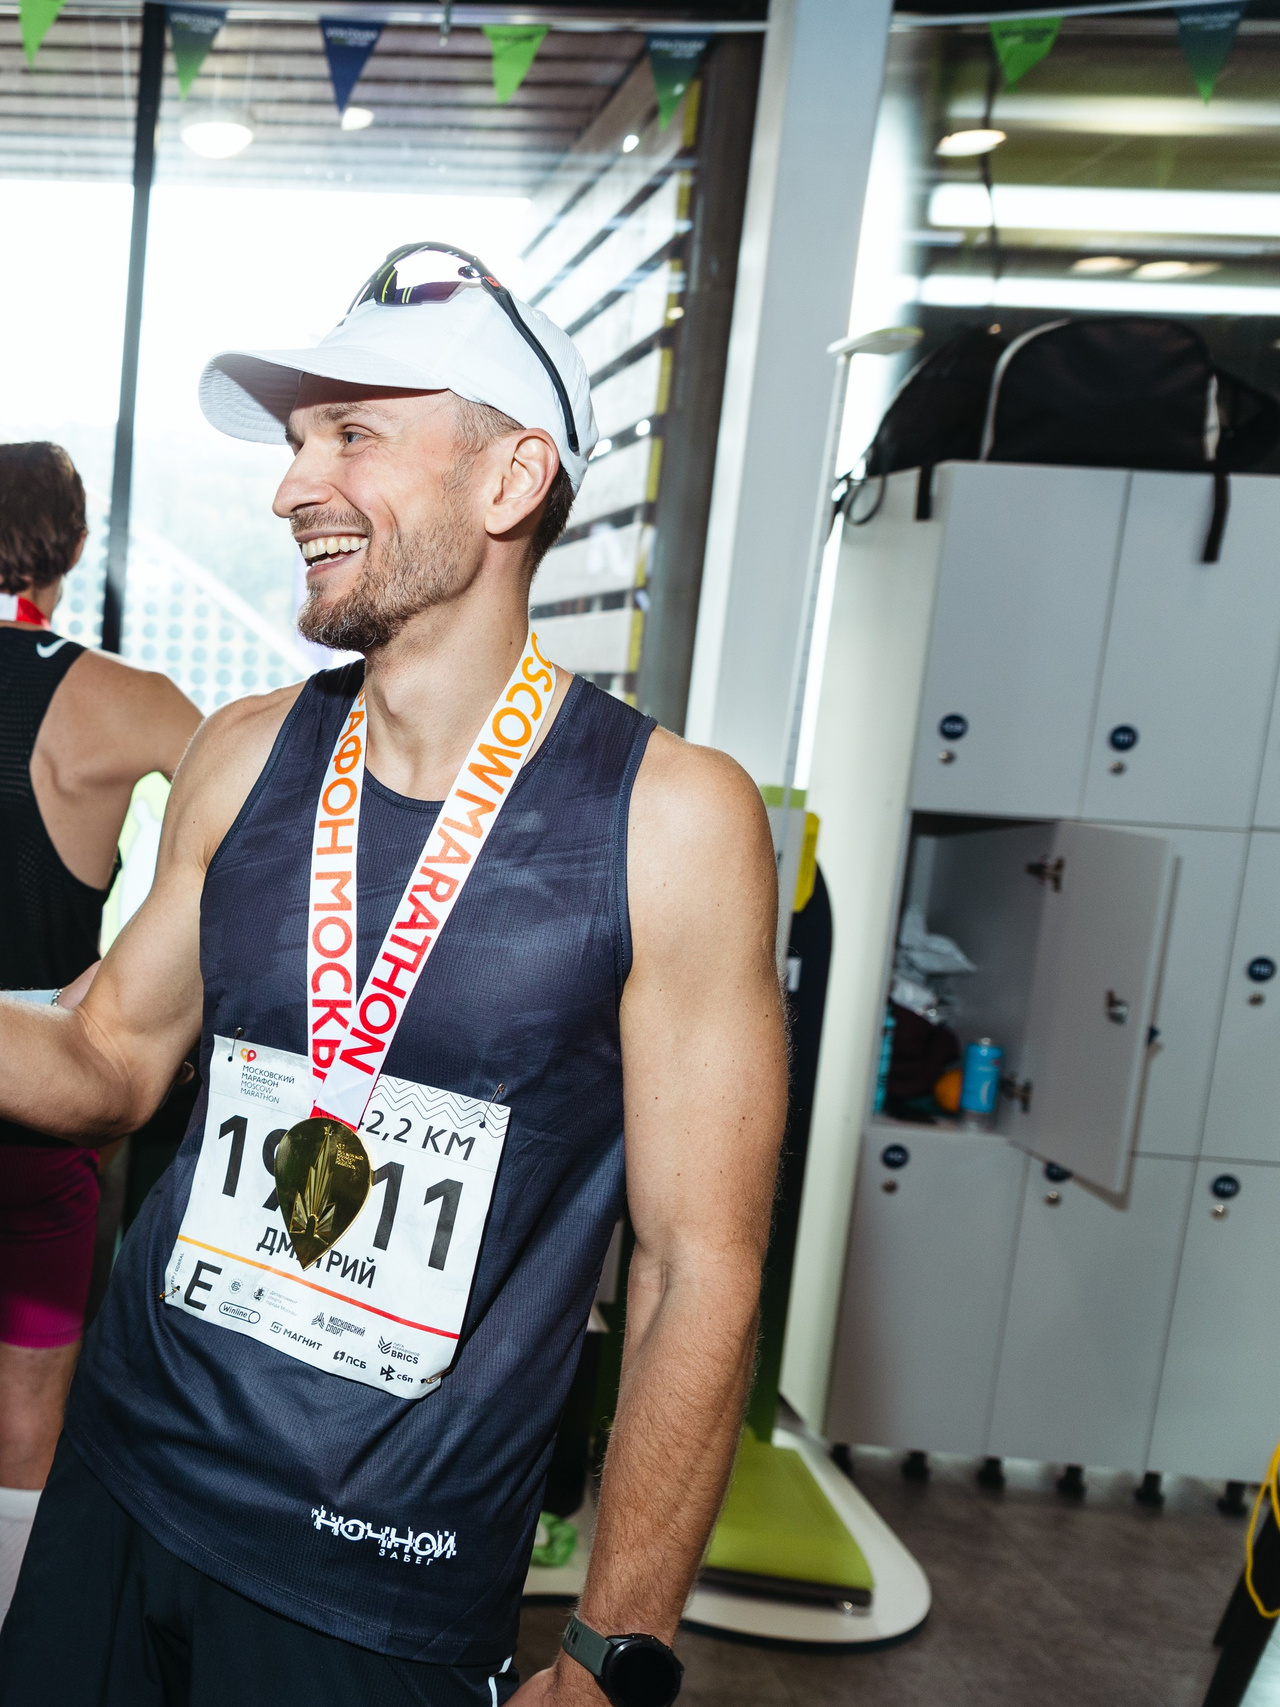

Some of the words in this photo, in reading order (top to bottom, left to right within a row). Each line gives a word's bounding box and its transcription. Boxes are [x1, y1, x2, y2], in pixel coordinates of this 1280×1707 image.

[339, 788, 496, 1075] MARATHON
[241, 1073, 279, 1088] МАРАФОН
[242, 1065, 295, 1084] МОСКОВСКИЙ
[240, 1080, 274, 1094] MOSCOW
[240, 1088, 280, 1104] MARATHON
[358, 1110, 412, 1144] 2,2
[422, 1125, 477, 1161] КМ
[256, 1226, 377, 1289] ДМРИЙ
[223, 1304, 248, 1318] Winline
[325, 1324, 344, 1337] СПОРТ
[328, 1315, 366, 1337] МОСКОВСКИЙ
[283, 1328, 323, 1350] МАГНИТ
[345, 1355, 367, 1369] ПСБ
[391, 1350, 419, 1364] BRICS
[378, 1548, 433, 1566] ЗАБЕГ
